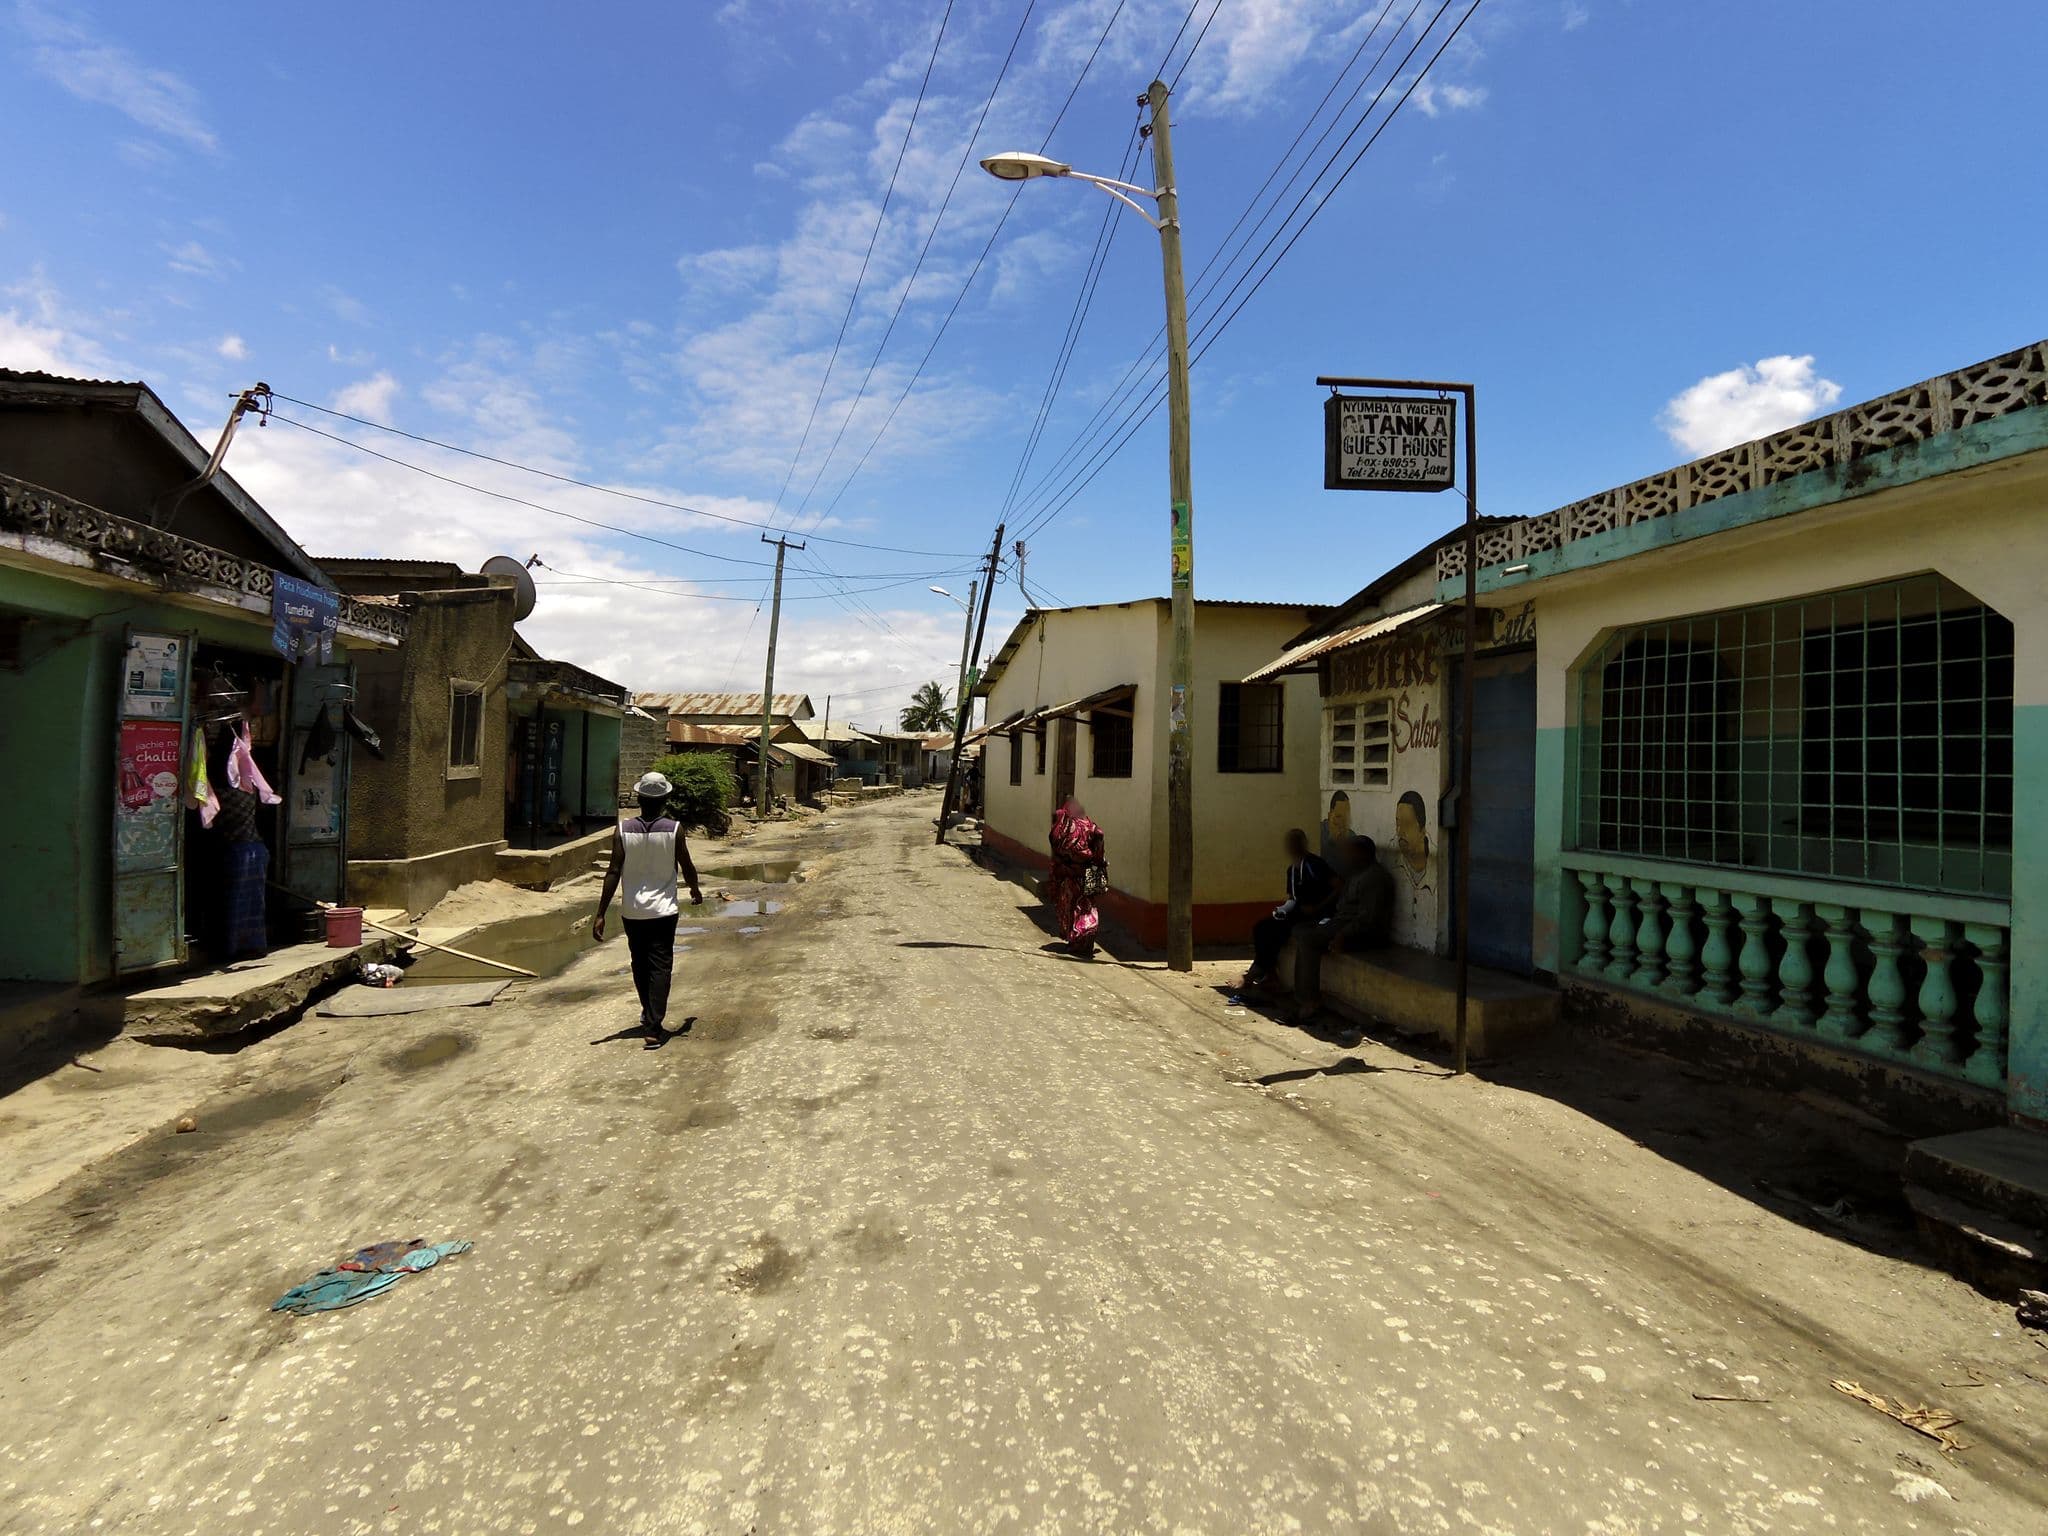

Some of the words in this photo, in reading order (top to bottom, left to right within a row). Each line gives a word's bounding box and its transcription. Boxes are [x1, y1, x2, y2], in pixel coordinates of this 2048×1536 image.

[1343, 402, 1389, 414] NYUMBA
[1406, 403, 1447, 416] WAGENI
[1343, 436, 1399, 456] GUEST
[1402, 438, 1447, 458] HOUSE
[136, 751, 179, 762] chalii
[547, 721, 561, 802] SALON
